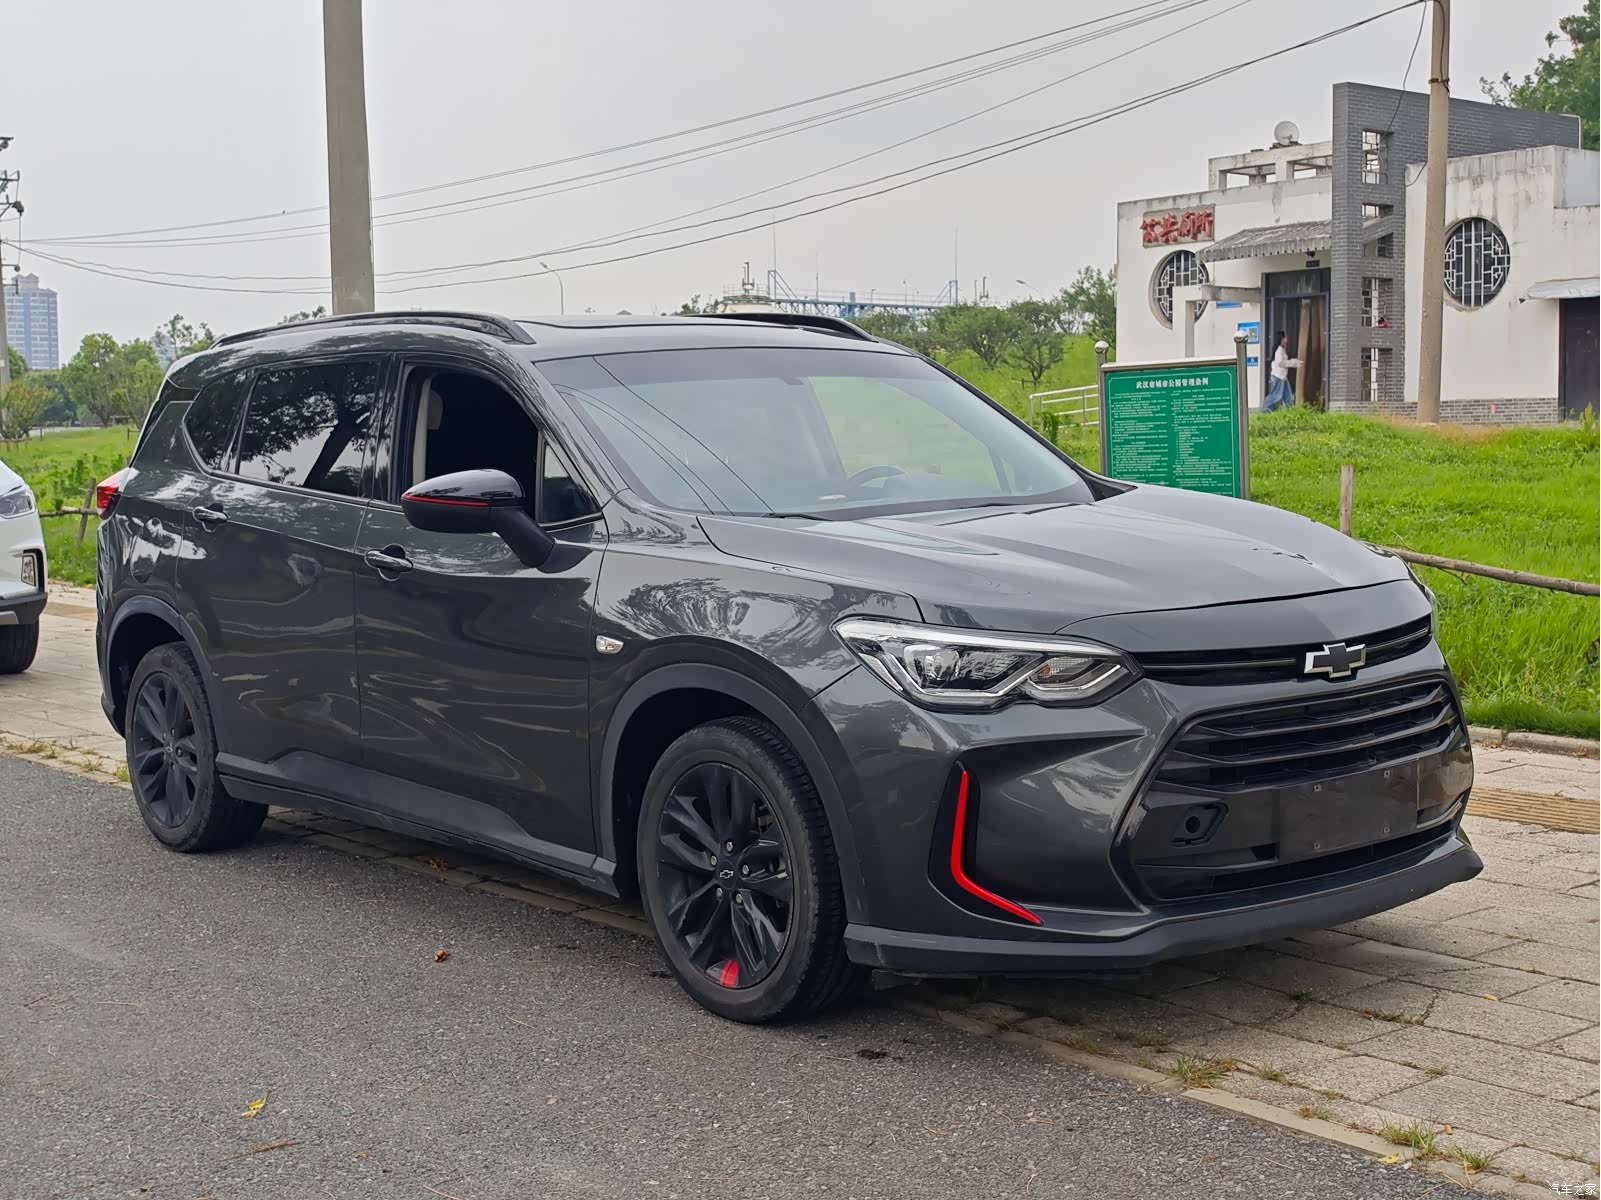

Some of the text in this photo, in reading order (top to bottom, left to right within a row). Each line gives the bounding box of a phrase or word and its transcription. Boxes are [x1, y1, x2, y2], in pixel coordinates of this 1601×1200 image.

[1136, 377, 1209, 389] 武汉市城市公园管理条例
